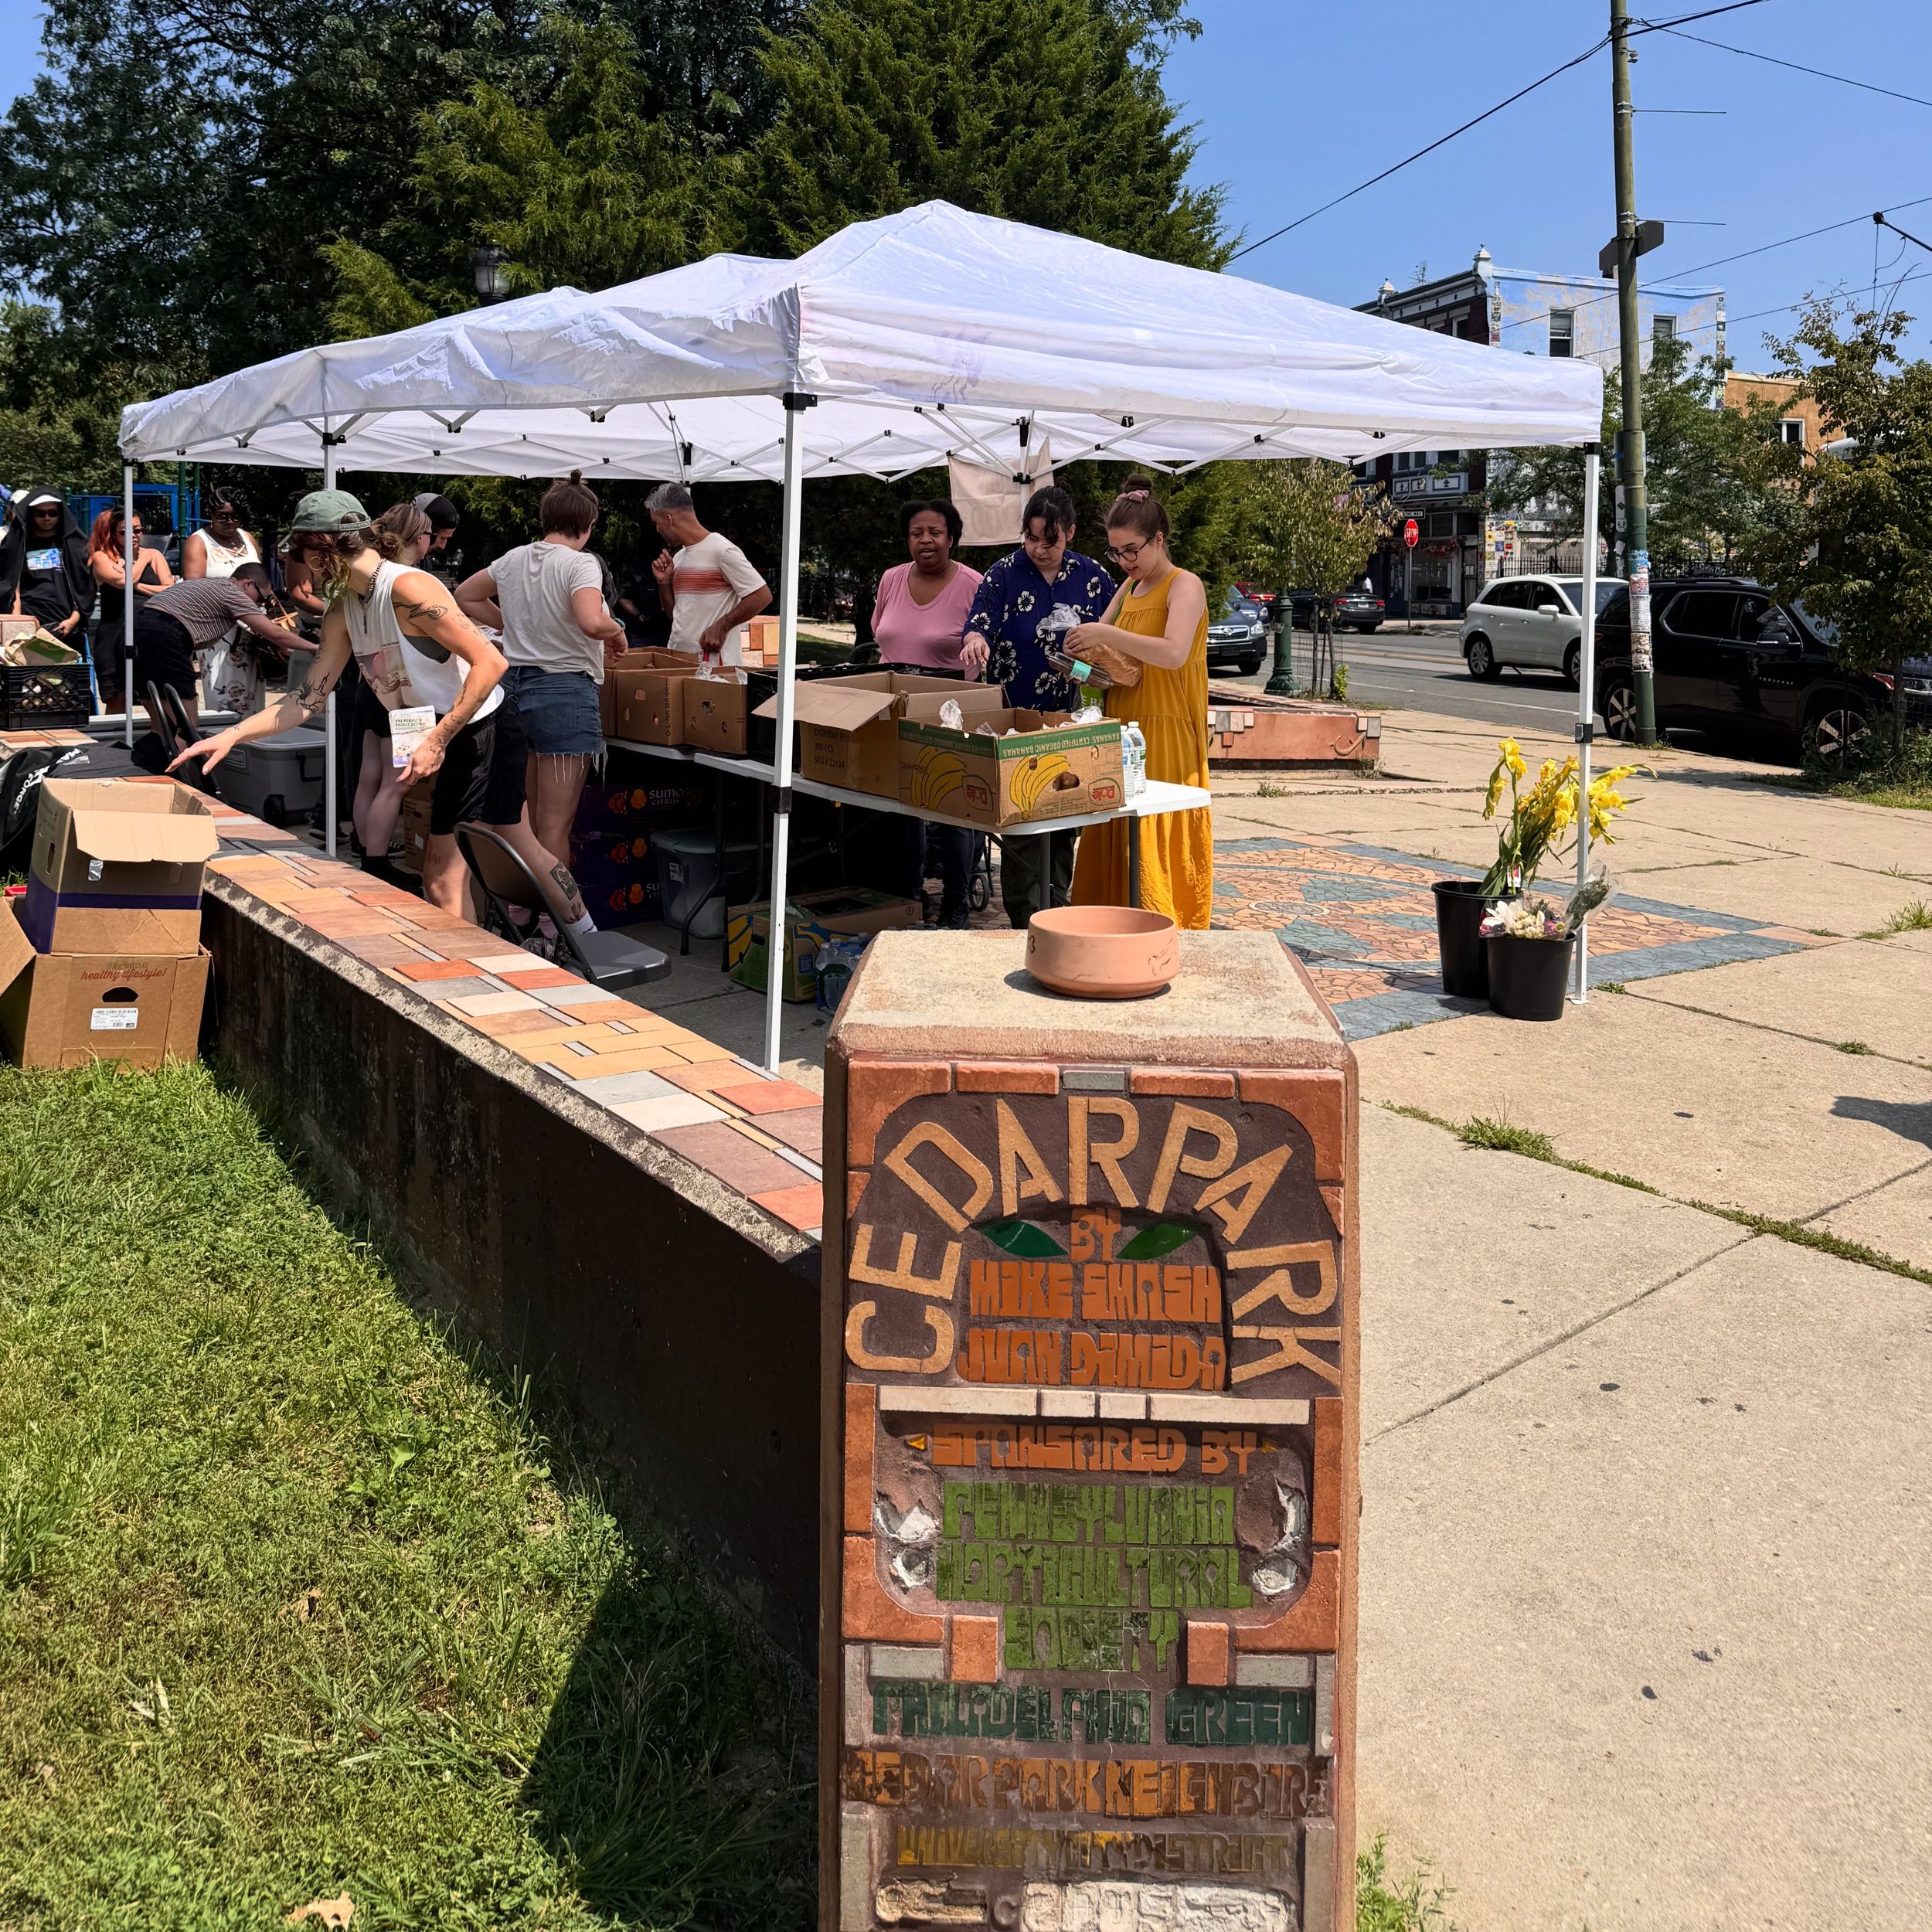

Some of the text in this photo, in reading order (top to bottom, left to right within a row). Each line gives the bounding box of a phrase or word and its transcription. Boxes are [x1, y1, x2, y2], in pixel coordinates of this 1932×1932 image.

[1406, 528, 1418, 538] STOP
[1062, 736, 1090, 749] CERTIFIED
[1093, 732, 1121, 743] BANANAS
[1002, 745, 1034, 757] BANANAS
[1034, 740, 1062, 753] ORGANIC
[814, 755, 825, 766] SKU
[966, 787, 988, 804] Dole
[1093, 787, 1115, 801] Dole
[81, 968, 167, 981] healthy lifestyle!
[1070, 1209, 1121, 1261] BY
[1082, 1263, 1223, 1323] SMASH
[958, 1328, 1061, 1386] JUAN
[933, 1423, 1257, 1475] SPONSORED BY
[1165, 1688, 1310, 1747] GREEN
[994, 1757, 1100, 1814] PARK
